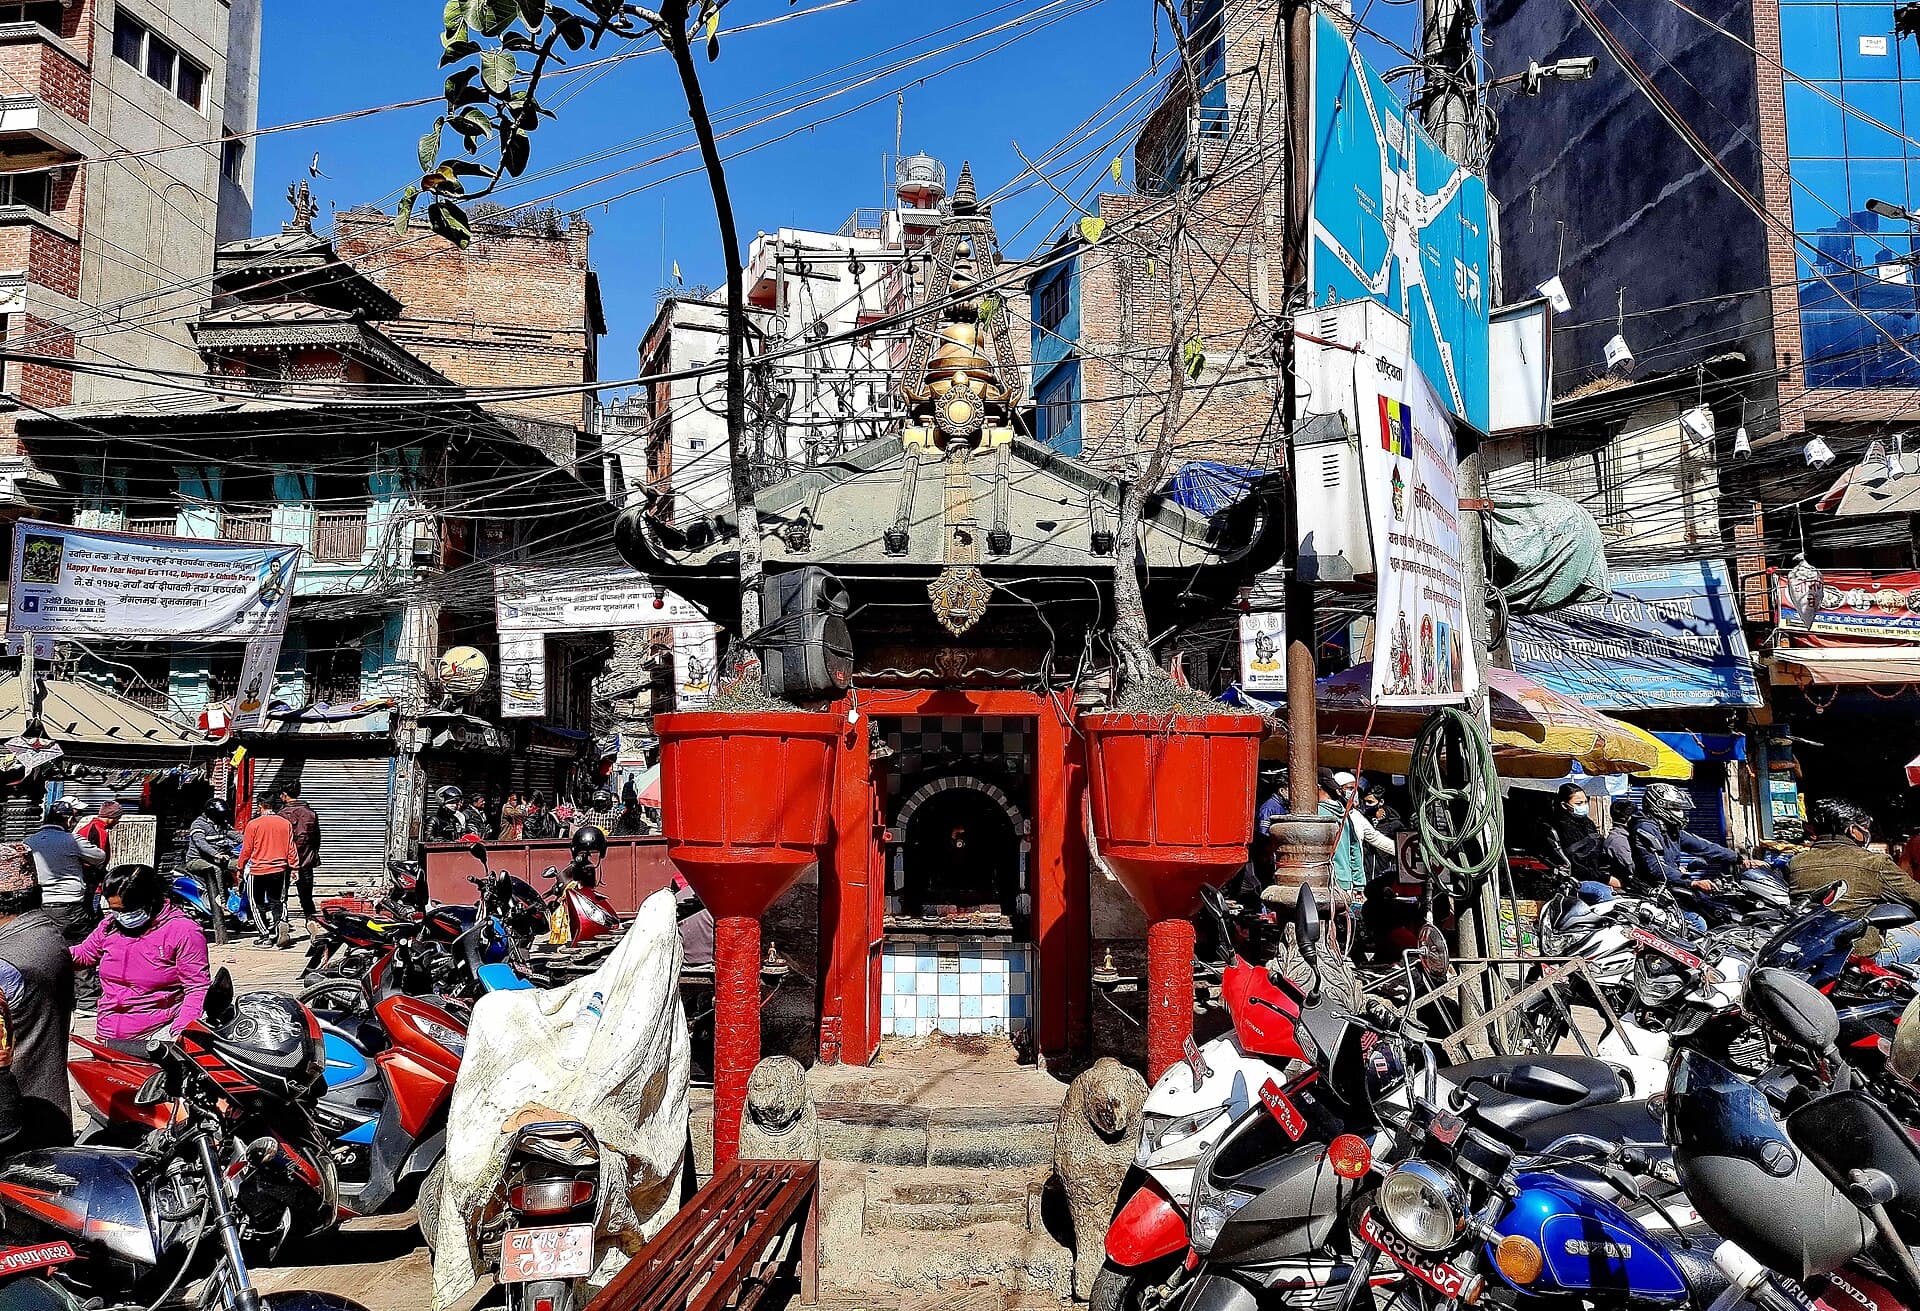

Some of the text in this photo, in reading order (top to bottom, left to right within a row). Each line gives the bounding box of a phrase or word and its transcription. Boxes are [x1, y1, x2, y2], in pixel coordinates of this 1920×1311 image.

[1370, 102, 1382, 138] Square
[1338, 246, 1372, 289] To Bir Hospital
[66, 563, 90, 573] Happy
[92, 565, 107, 573] New
[109, 566, 125, 574] Year
[127, 567, 146, 576] Nepal
[96, 580, 120, 589] ११४२
[143, 580, 157, 590] वर्ष
[1611, 593, 1643, 623] प्रहरी
[1565, 1239, 1631, 1259] SUZUKI
